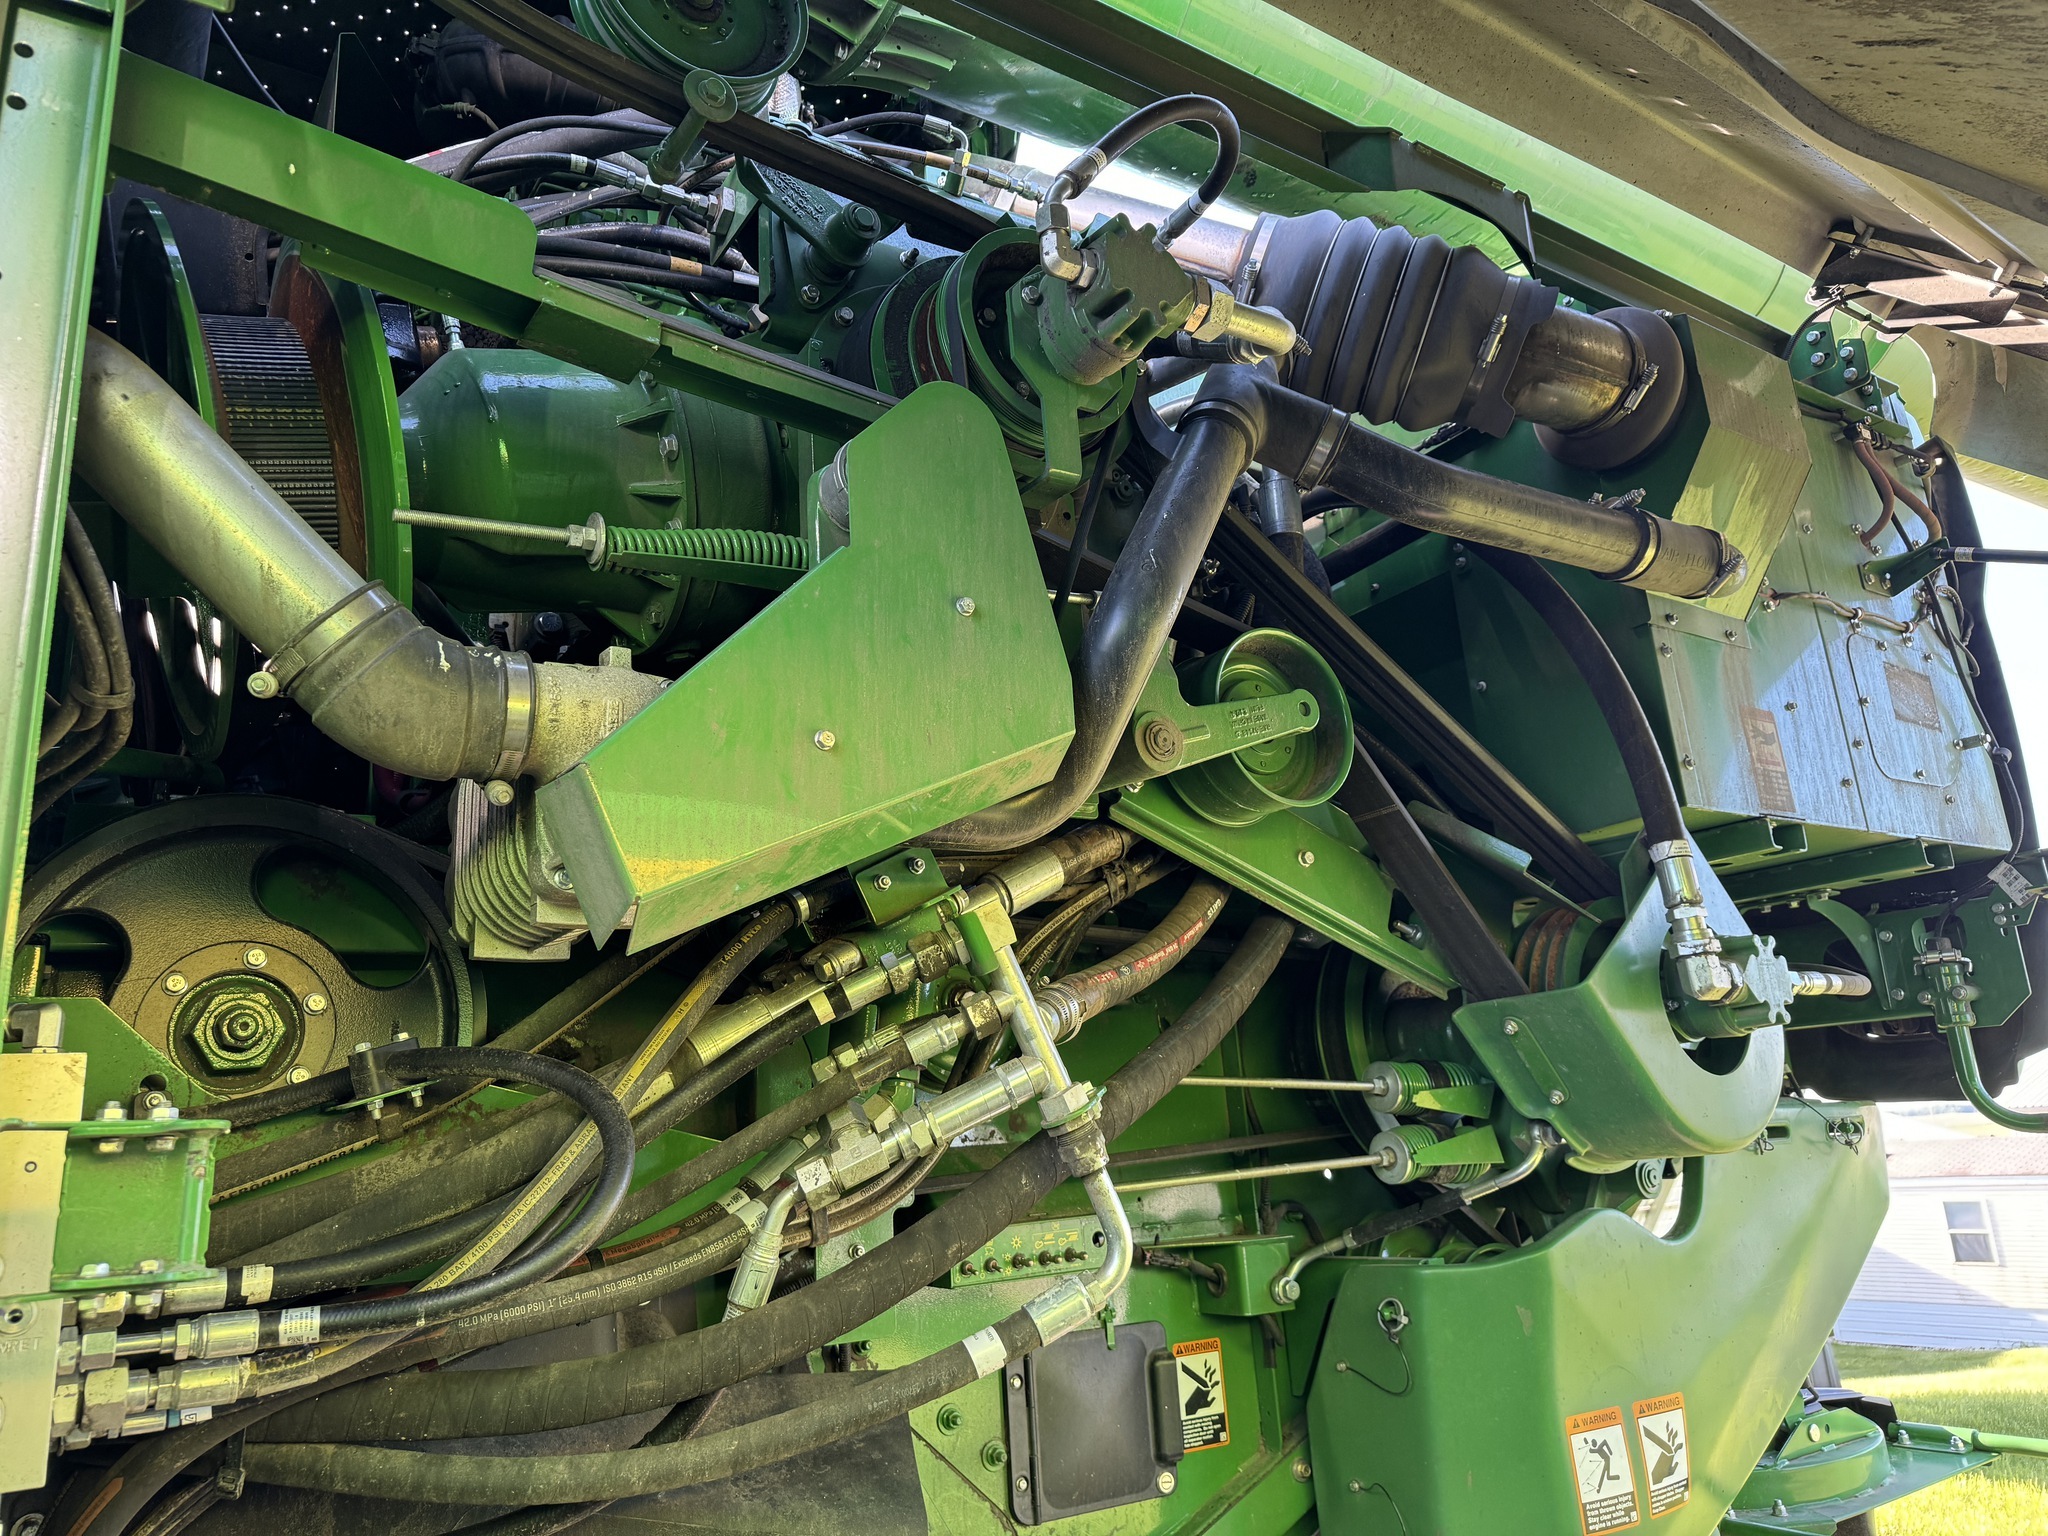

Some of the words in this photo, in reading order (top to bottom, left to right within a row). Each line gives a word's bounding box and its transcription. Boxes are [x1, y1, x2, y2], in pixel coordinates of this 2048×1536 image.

[761, 169, 789, 193] MADE
[786, 189, 798, 200] IN
[795, 197, 824, 222] CHINA
[1660, 546, 1680, 562] AIR
[1683, 552, 1714, 571] FLOW
[720, 942, 743, 965] T4000
[761, 902, 788, 925] DIEHA
[1029, 940, 1059, 973] DIEHARD
[433, 1273, 449, 1288] 280
[449, 1258, 468, 1277] BAR
[471, 1240, 490, 1259] 4100
[487, 1229, 501, 1245] PSI
[502, 1208, 523, 1230] MSHA
[552, 1152, 572, 1176] FRAS
[575, 1123, 597, 1149] ABRAS
[615, 1073, 635, 1097] STANT
[458, 1316, 478, 1328] 42.0
[480, 1311, 499, 1323] MPa
[603, 1283, 616, 1294] ISO
[617, 1276, 637, 1291] 3862
[638, 1271, 653, 1283] R15
[654, 1266, 669, 1279] 4SH
[674, 1252, 701, 1270] Exceeds
[702, 1241, 724, 1257] EN856
[723, 1234, 738, 1247] R15
[1183, 1341, 1219, 1354] WARNING
[1645, 1397, 1680, 1412] WARNING
[1581, 1412, 1617, 1427] WARNING
[1586, 1502, 1600, 1510] Avoid
[1601, 1498, 1617, 1507] serious
[1618, 1494, 1632, 1504] injury
[1587, 1509, 1599, 1517] from
[1600, 1505, 1615, 1514] thrown
[1617, 1501, 1634, 1511] objects.
[1588, 1515, 1599, 1524] Stay
[1600, 1513, 1612, 1521] clear
[1612, 1509, 1624, 1518] while
[1589, 1522, 1605, 1531] engine
[1612, 1515, 1630, 1526] running.
